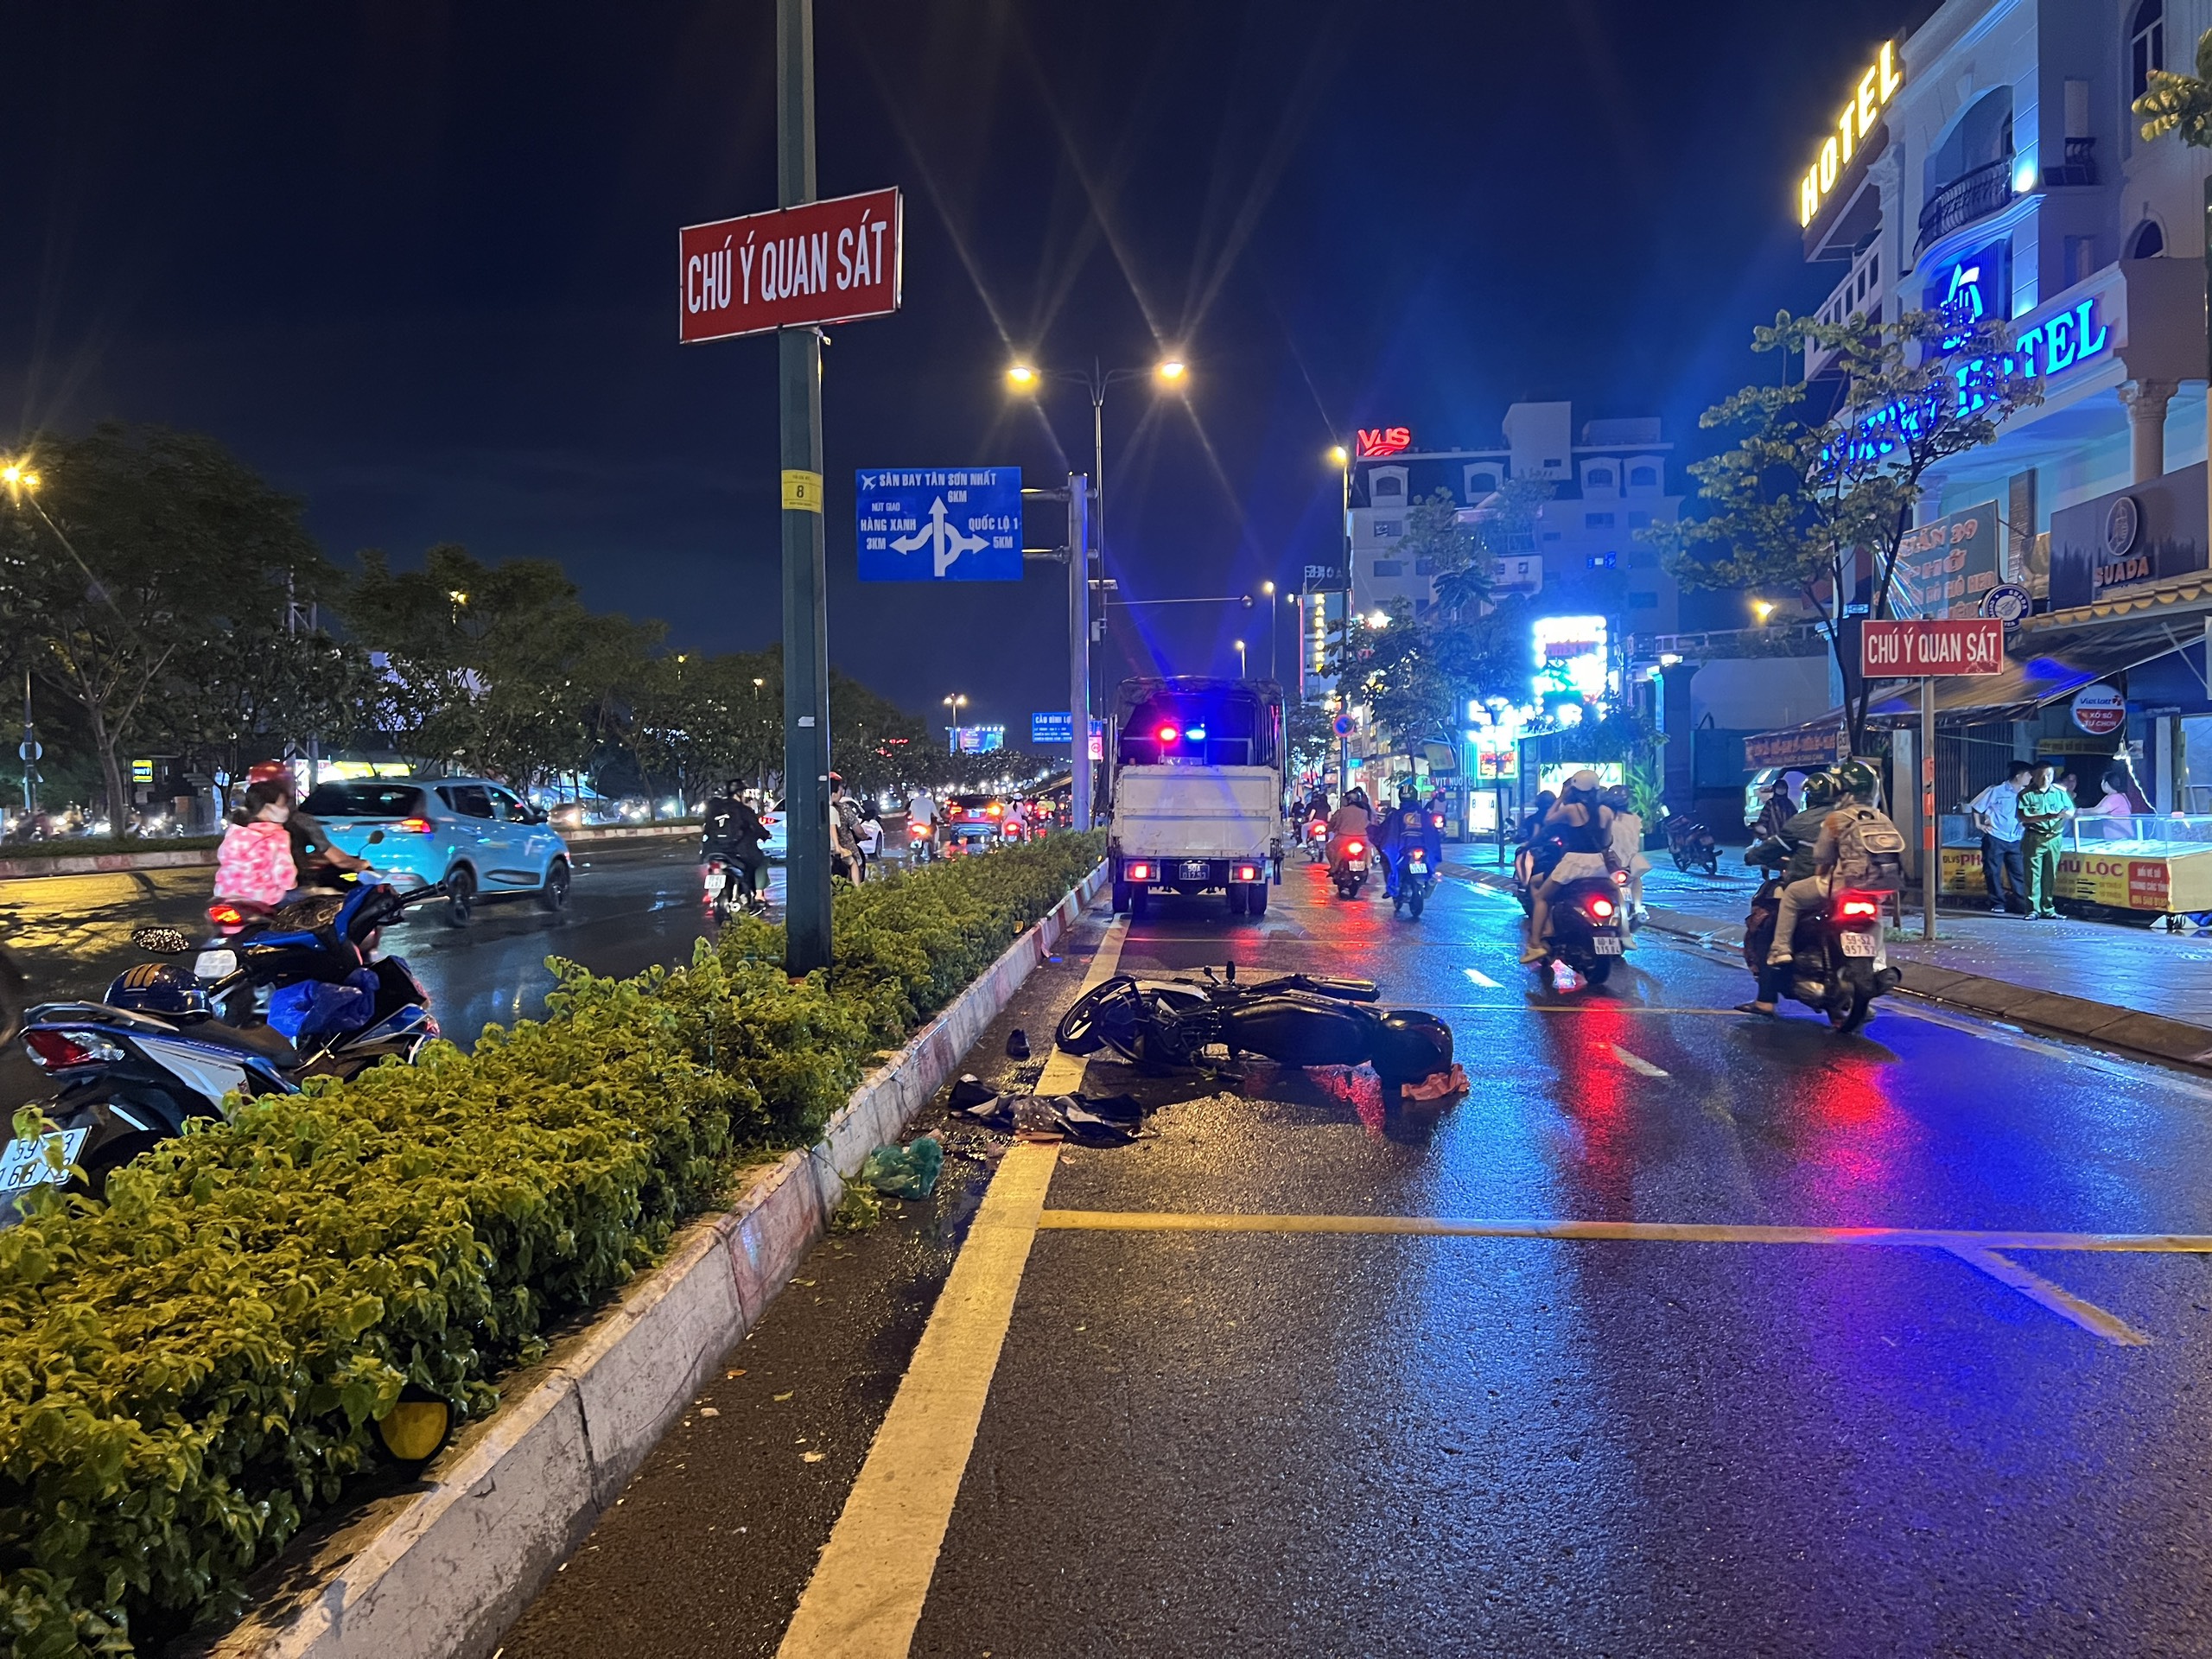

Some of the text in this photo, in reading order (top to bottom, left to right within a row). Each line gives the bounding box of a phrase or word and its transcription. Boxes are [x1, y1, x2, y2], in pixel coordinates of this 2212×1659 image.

[1800, 39, 1902, 229] HOTEL
[688, 208, 887, 314] CHÚ Ý QUAN SÁT
[1357, 427, 1410, 451] VUS
[879, 470, 996, 486] SÂN BAY TÂN SƠN NHẤT
[797, 485, 804, 499] 8
[948, 491, 967, 503] 6KM
[886, 502, 900, 512] GIAO
[861, 517, 917, 531] HÀNG XANH
[968, 514, 1019, 533] QUỐC LỘ 1
[1950, 518, 1978, 544] 39
[867, 537, 887, 550] 3KM
[993, 536, 1014, 549] 5KM
[2093, 556, 2150, 588] SUADA
[1967, 571, 1996, 594] HEO
[1868, 625, 1998, 664] CHÚ Ý QUAN SÁT
[1961, 854, 1982, 866] PH
